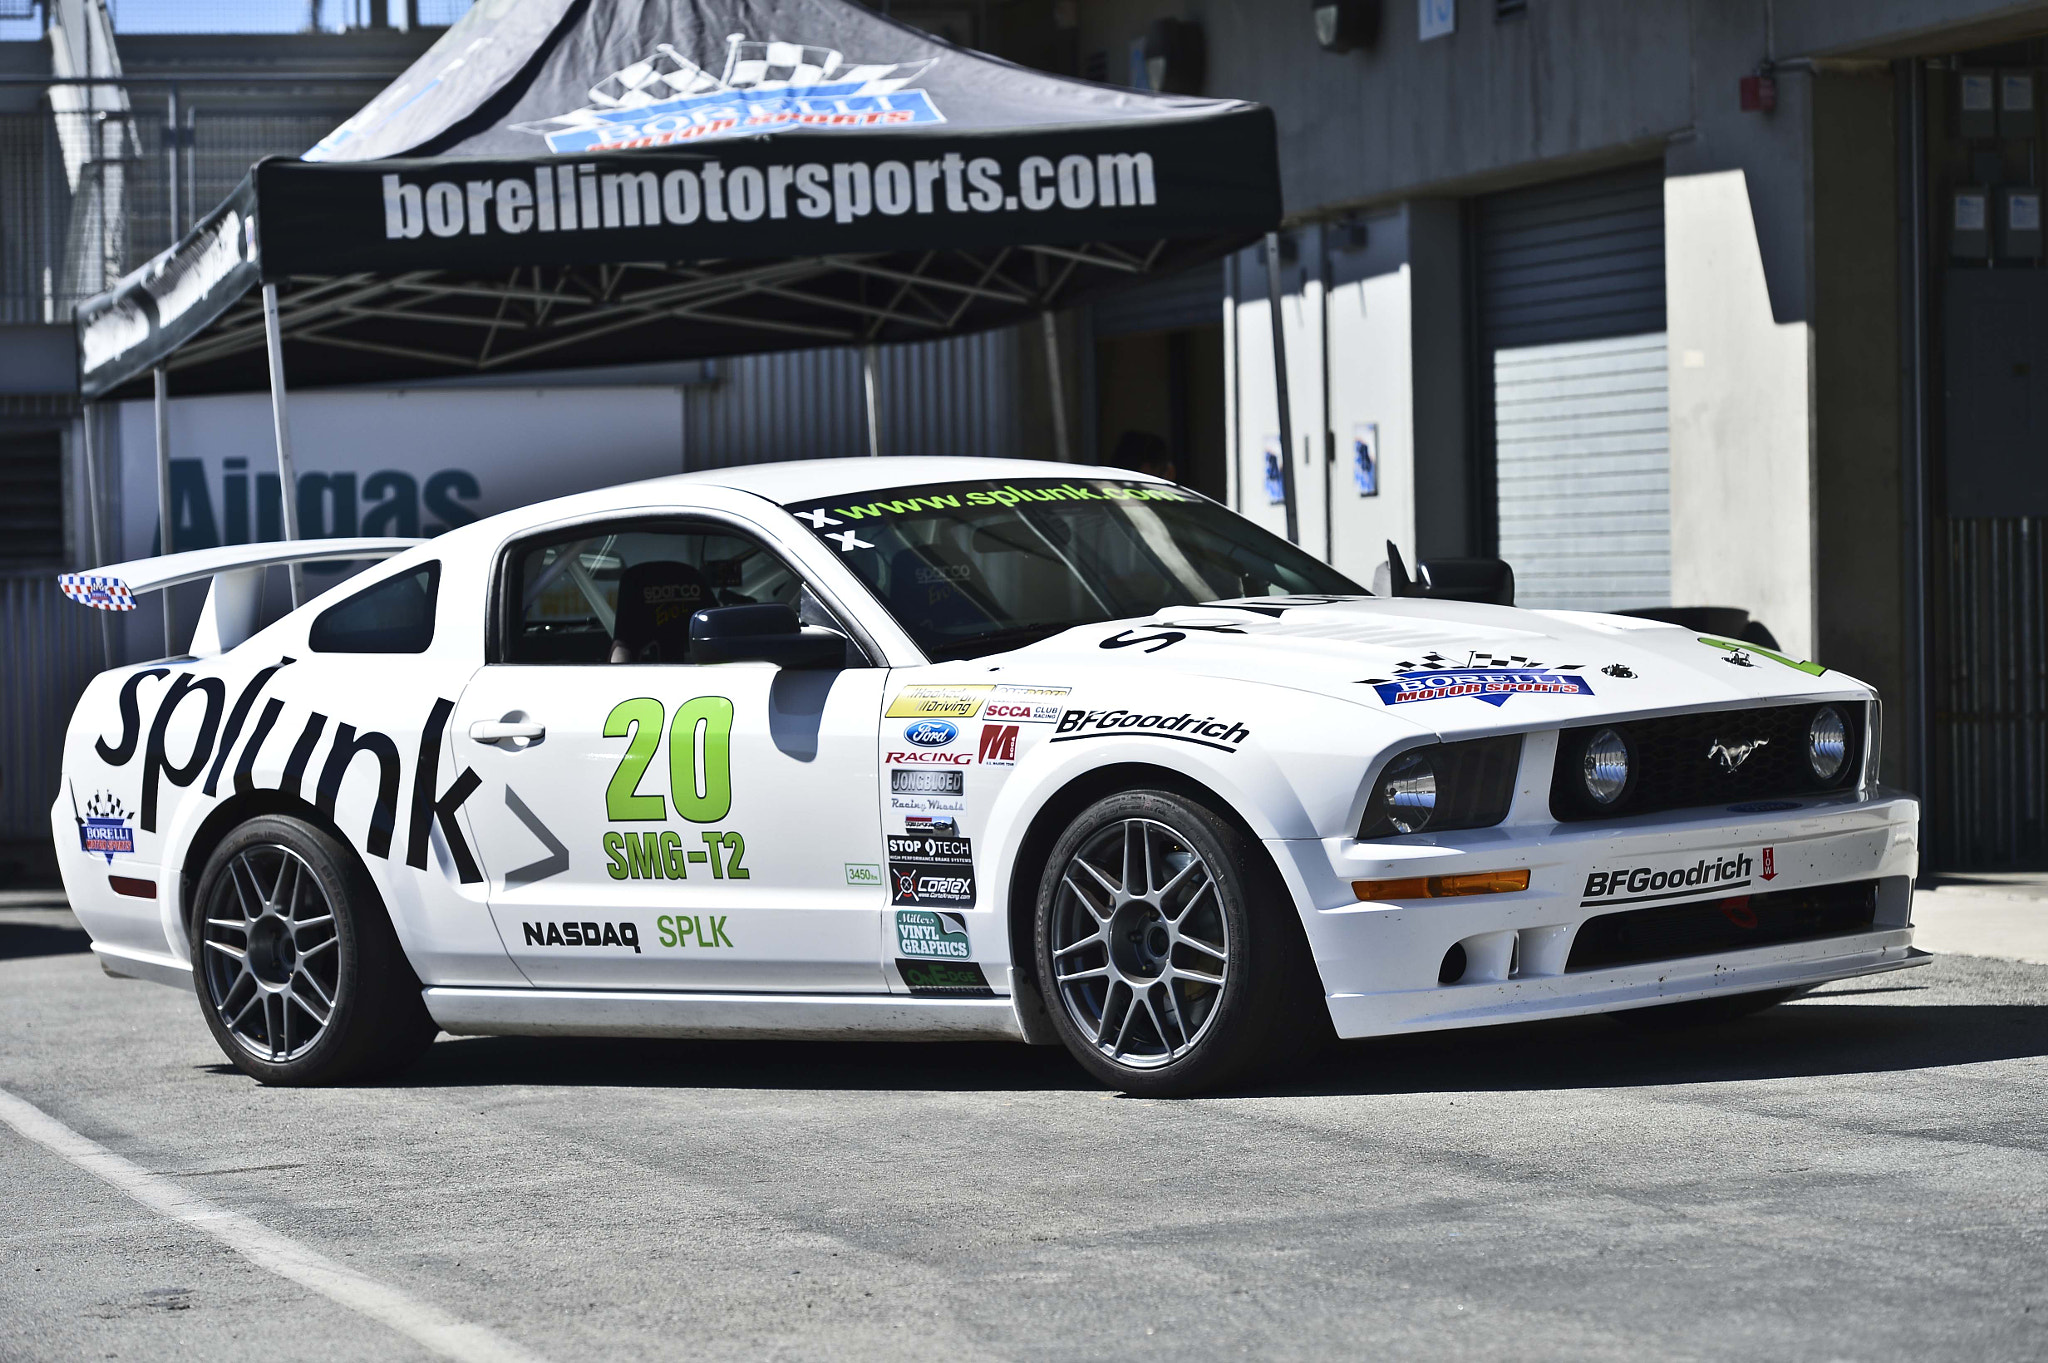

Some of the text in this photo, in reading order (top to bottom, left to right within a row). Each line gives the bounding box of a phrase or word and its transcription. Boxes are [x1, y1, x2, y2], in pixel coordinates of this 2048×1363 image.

[382, 152, 1156, 240] borellimotorsports.com
[834, 484, 1185, 521] www.splunk.com
[151, 457, 481, 575] Airgas
[1400, 675, 1566, 691] BORELLI
[1396, 683, 1580, 703] MOTOR SPORTS
[926, 701, 971, 715] Driving
[986, 705, 1058, 718] SCCA CLUB
[912, 722, 948, 743] Ford
[1056, 710, 1250, 743] BFGoodrich
[603, 696, 734, 823] 20
[885, 752, 973, 765] RACING
[892, 772, 961, 791] JONGBLOED
[891, 798, 926, 812] Racing
[86, 827, 129, 840] BORELLI
[603, 831, 750, 880] SMG-T2
[889, 840, 969, 855] STOP TECH
[1764, 850, 1772, 874] TOW
[849, 868, 870, 880] 3450
[1583, 853, 1752, 897] BFGoodrich
[522, 915, 734, 954] NASDAQ SPLK
[899, 924, 939, 940] VINYL
[901, 939, 968, 957] GRAPHICS
